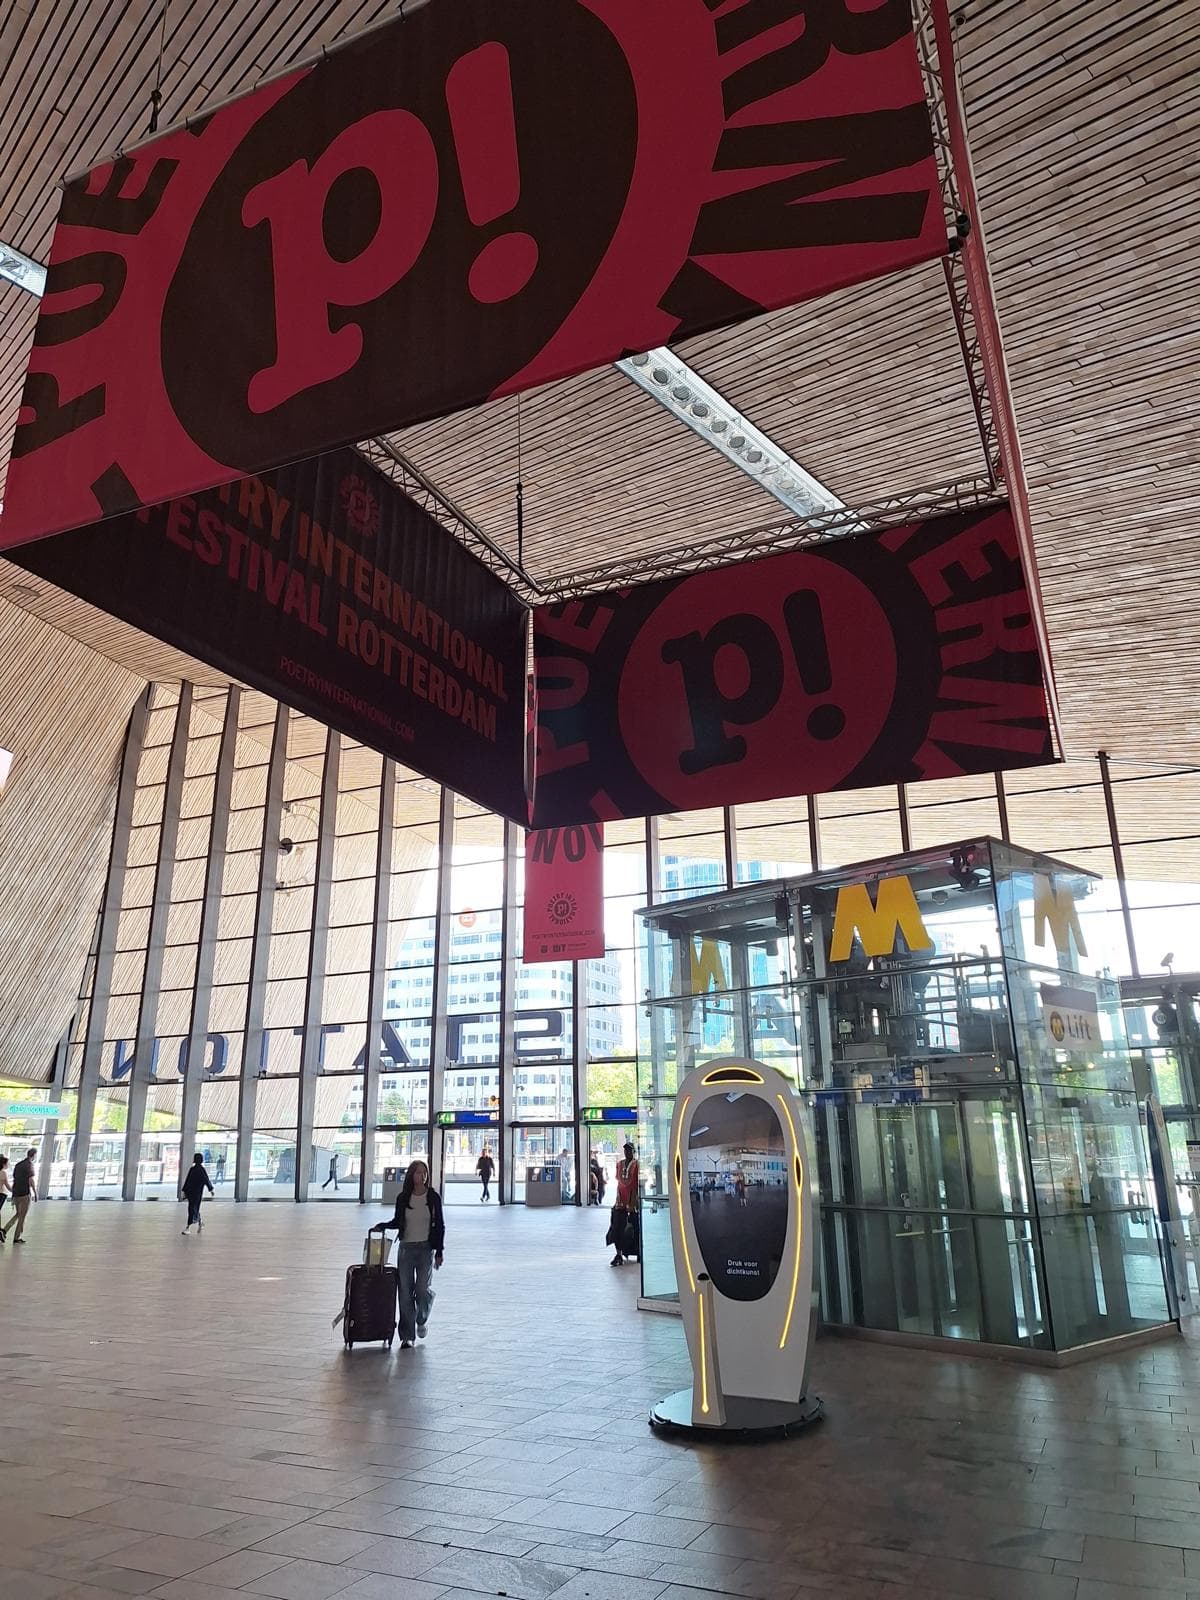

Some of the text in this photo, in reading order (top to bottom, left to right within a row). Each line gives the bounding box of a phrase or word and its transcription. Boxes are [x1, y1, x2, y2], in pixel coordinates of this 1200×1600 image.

[297, 511, 509, 701] INTERNATIONAL
[336, 602, 497, 743] ROTTERDAM
[829, 875, 933, 964] M
[1033, 874, 1089, 958] M
[1066, 1014, 1092, 1041] Lift
[726, 1268, 760, 1276] dichtkunst
[727, 1259, 742, 1267] Druk
